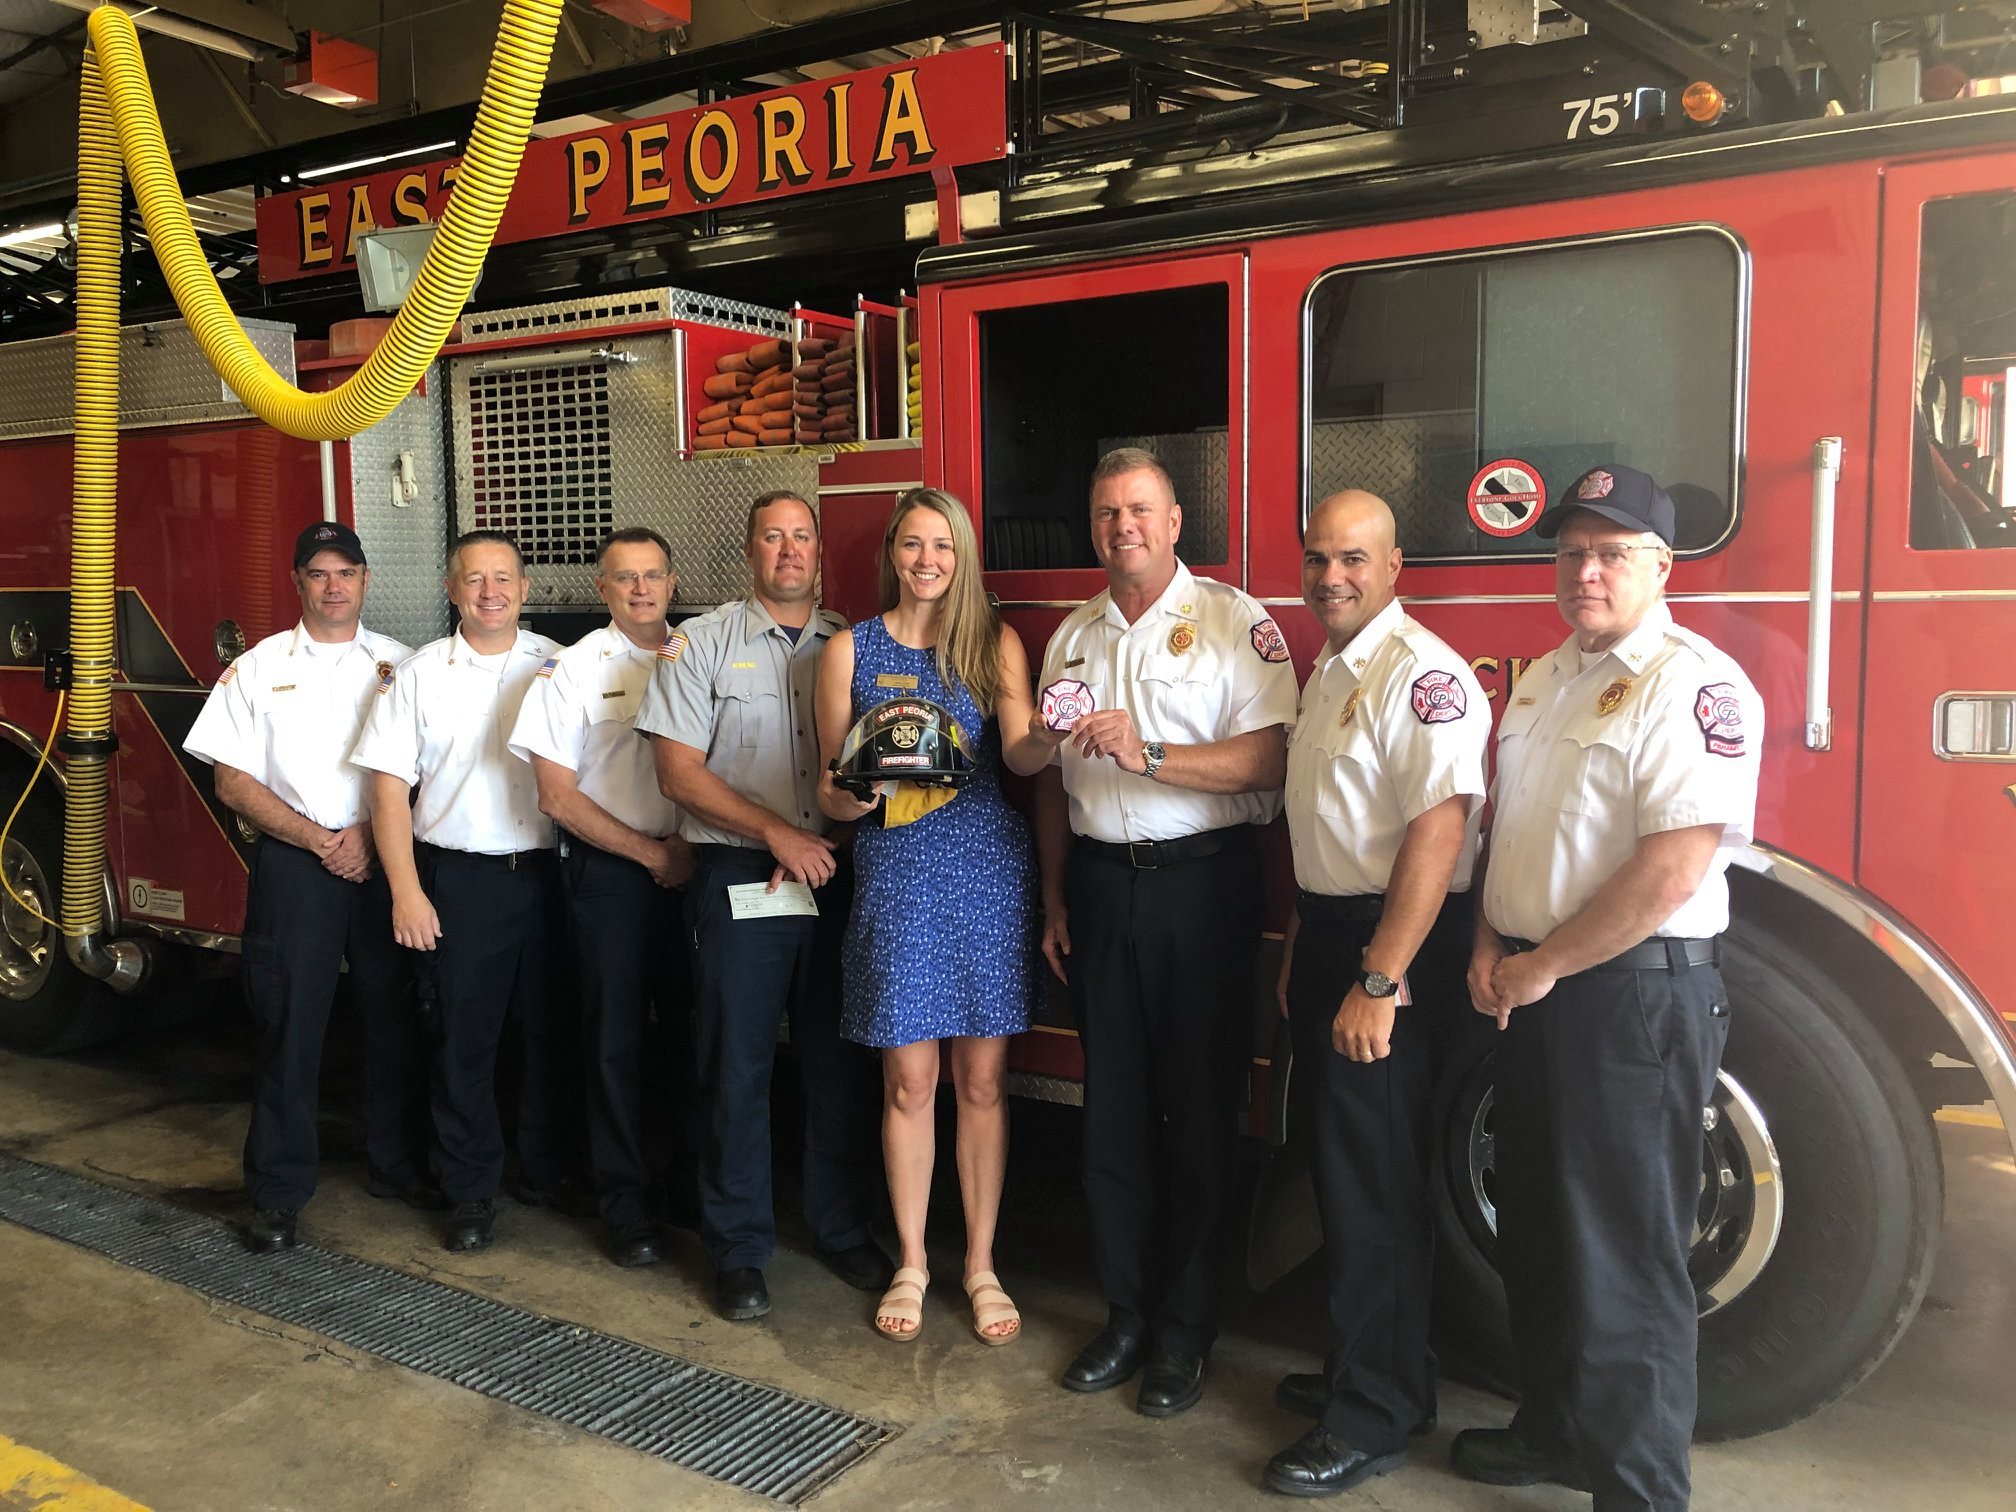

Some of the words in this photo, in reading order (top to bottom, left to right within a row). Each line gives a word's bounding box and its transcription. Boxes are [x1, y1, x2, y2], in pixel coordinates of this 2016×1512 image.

[1563, 92, 1632, 140] 75'
[566, 68, 937, 224] PEORIA
[1470, 496, 1502, 504] EVERYONE
[1523, 493, 1542, 501] HOME
[1426, 676, 1442, 684] FIRE
[1057, 686, 1072, 694] FIRE
[879, 706, 900, 722] EAST
[903, 706, 935, 722] PEORIA
[882, 756, 930, 765] FIREFIGHTER
